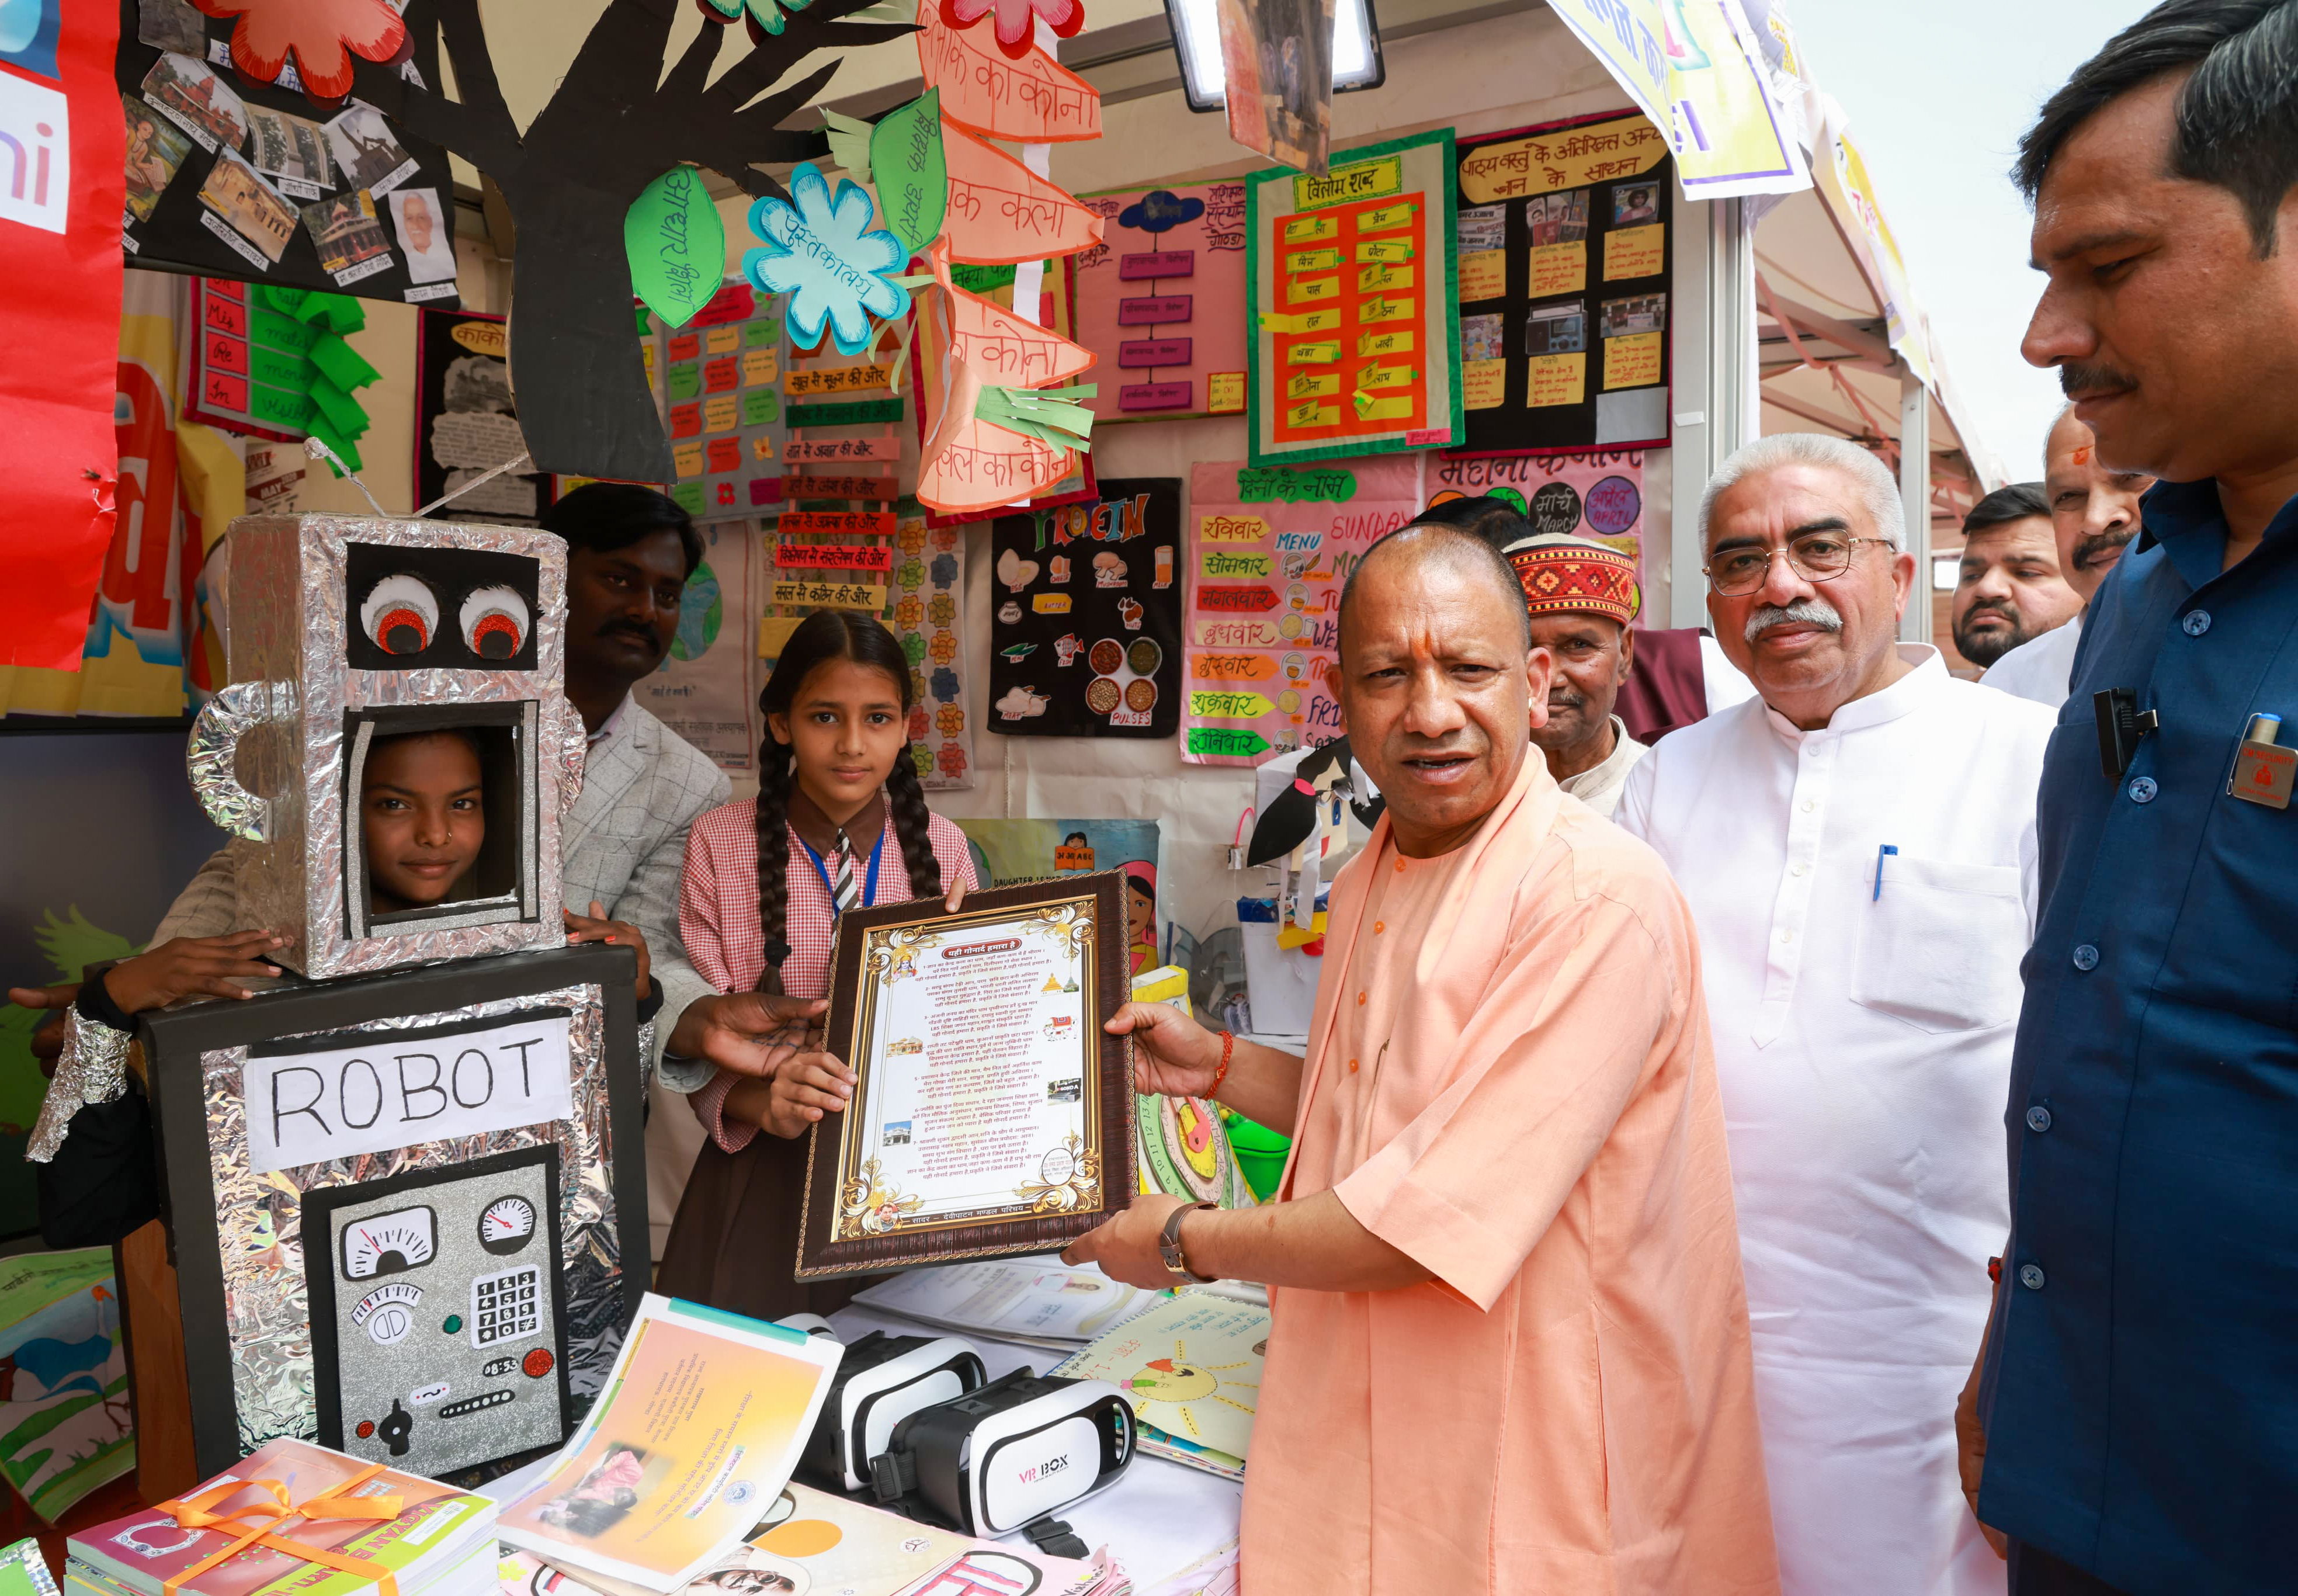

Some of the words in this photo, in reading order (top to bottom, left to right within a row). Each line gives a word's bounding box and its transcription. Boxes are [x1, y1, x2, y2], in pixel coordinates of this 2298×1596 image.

[976, 58, 1011, 106] का
[1019, 58, 1096, 129] कोना
[1462, 157, 1498, 178] पाठ्य
[1525, 143, 1550, 164] के
[1349, 168, 1379, 193] शब्द
[1543, 167, 1566, 187] के
[1584, 157, 1641, 181] साधन
[1001, 193, 1075, 238] कला
[780, 215, 875, 300] पुस्तकालय
[456, 322, 507, 349] काको
[213, 341, 233, 363] Re
[981, 320, 1068, 376] कोना
[1278, 470, 1297, 498] के
[1303, 475, 1349, 498] नाम
[1536, 487, 1573, 512] मार्च
[1205, 516, 1267, 539] रविवार
[1536, 514, 1578, 532] MARCH
[1593, 510, 1631, 526] APRIL
[1276, 533, 1321, 550] MENU
[1205, 552, 1268, 576] सोमवार
[775, 585, 796, 601] सरल
[836, 585, 851, 603] की
[1204, 624, 1275, 646] बुधवार
[1112, 712, 1151, 726] PULSES
[1191, 729, 1262, 754] शनिवार
[2256, 750, 2295, 766] SECURITY
[994, 876, 1033, 887] DAUGHTER
[948, 948, 962, 957] यही
[963, 944, 986, 955] गोनार्द
[987, 942, 1009, 953] हमारा
[1009, 941, 1016, 950] है
[271, 1038, 543, 1147] ROBOT
[1143, 1107, 1151, 1119] 13
[1145, 1126, 1154, 1136] 12
[1150, 1145, 1158, 1154] 11
[912, 1216, 930, 1224] सादर
[943, 1210, 973, 1221] देवीपाटन
[977, 1208, 998, 1217] मण्डल
[1002, 1205, 1024, 1214] परिचय
[481, 1283, 488, 1293] 1
[502, 1278, 512, 1288] 2
[522, 1274, 530, 1284] 3
[481, 1297, 491, 1309] 4
[503, 1294, 512, 1304] 5
[523, 1288, 530, 1298] 6
[482, 1315, 491, 1326] 7
[503, 1309, 512, 1320] 8
[522, 1304, 529, 1316] 9
[502, 1326, 512, 1335] 0
[484, 1359, 518, 1375] 08:53
[1019, 1467, 1036, 1484] VR
[1041, 1454, 1068, 1476] BOX
[366, 1503, 442, 1549] VIGYAN
